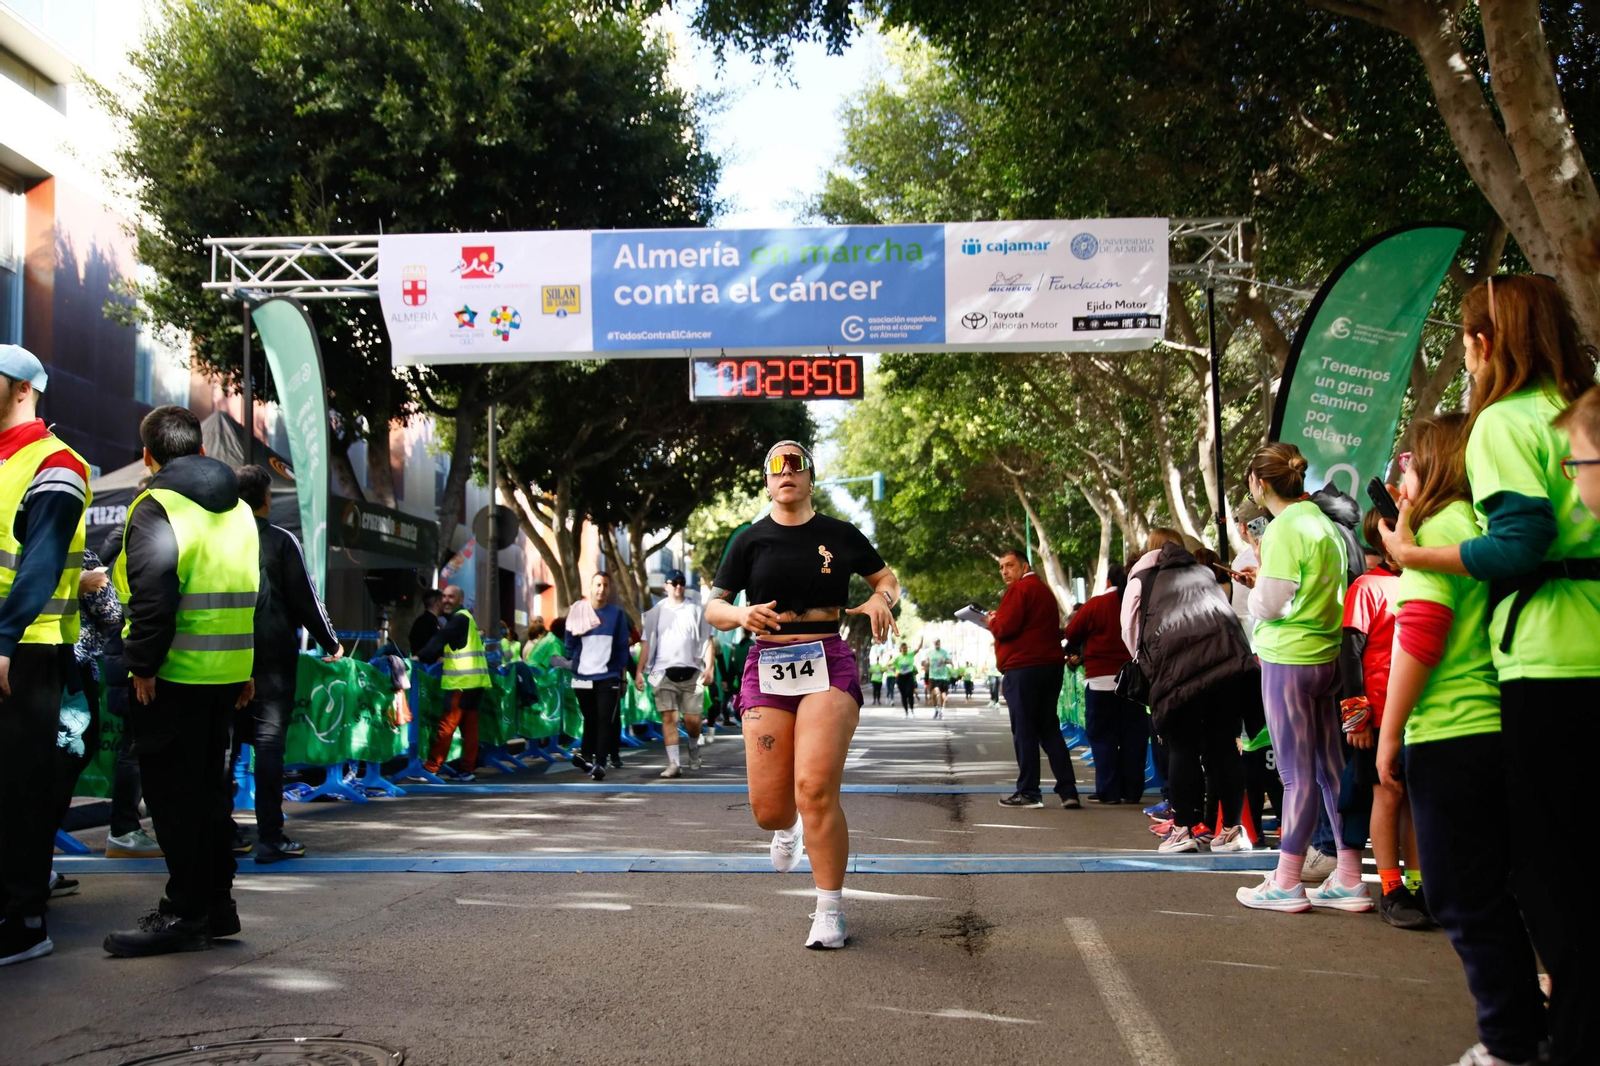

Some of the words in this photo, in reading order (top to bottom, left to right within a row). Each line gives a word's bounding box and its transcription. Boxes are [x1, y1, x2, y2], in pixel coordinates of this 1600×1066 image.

[986, 239, 1050, 256] cajamar
[1099, 238, 1155, 246] UNIVERSIDAD
[613, 241, 740, 269] Almería
[750, 245, 789, 265] en
[800, 237, 924, 264] marcha
[614, 279, 720, 306] contra
[729, 276, 761, 304] el
[769, 275, 883, 303] cáncer
[1049, 275, 1122, 291] Fundación
[546, 287, 576, 300] SOLAN
[1086, 301, 1112, 313] Ejido
[1115, 300, 1147, 310] Motor
[391, 310, 439, 323] ALMERÍA
[868, 316, 905, 324] asociación
[906, 315, 937, 323] española
[992, 311, 1024, 320] Toyota
[992, 321, 1028, 330] Alborán
[1030, 320, 1058, 329] Motor
[607, 330, 712, 341] #TodosContraElCáncer
[1321, 356, 1391, 382] Tenemos
[1314, 375, 1335, 389] un
[1336, 380, 1374, 397] gran
[1310, 392, 1368, 413] camino
[1305, 409, 1333, 423] por
[1302, 425, 1362, 446] delante
[770, 660, 815, 681] 314
